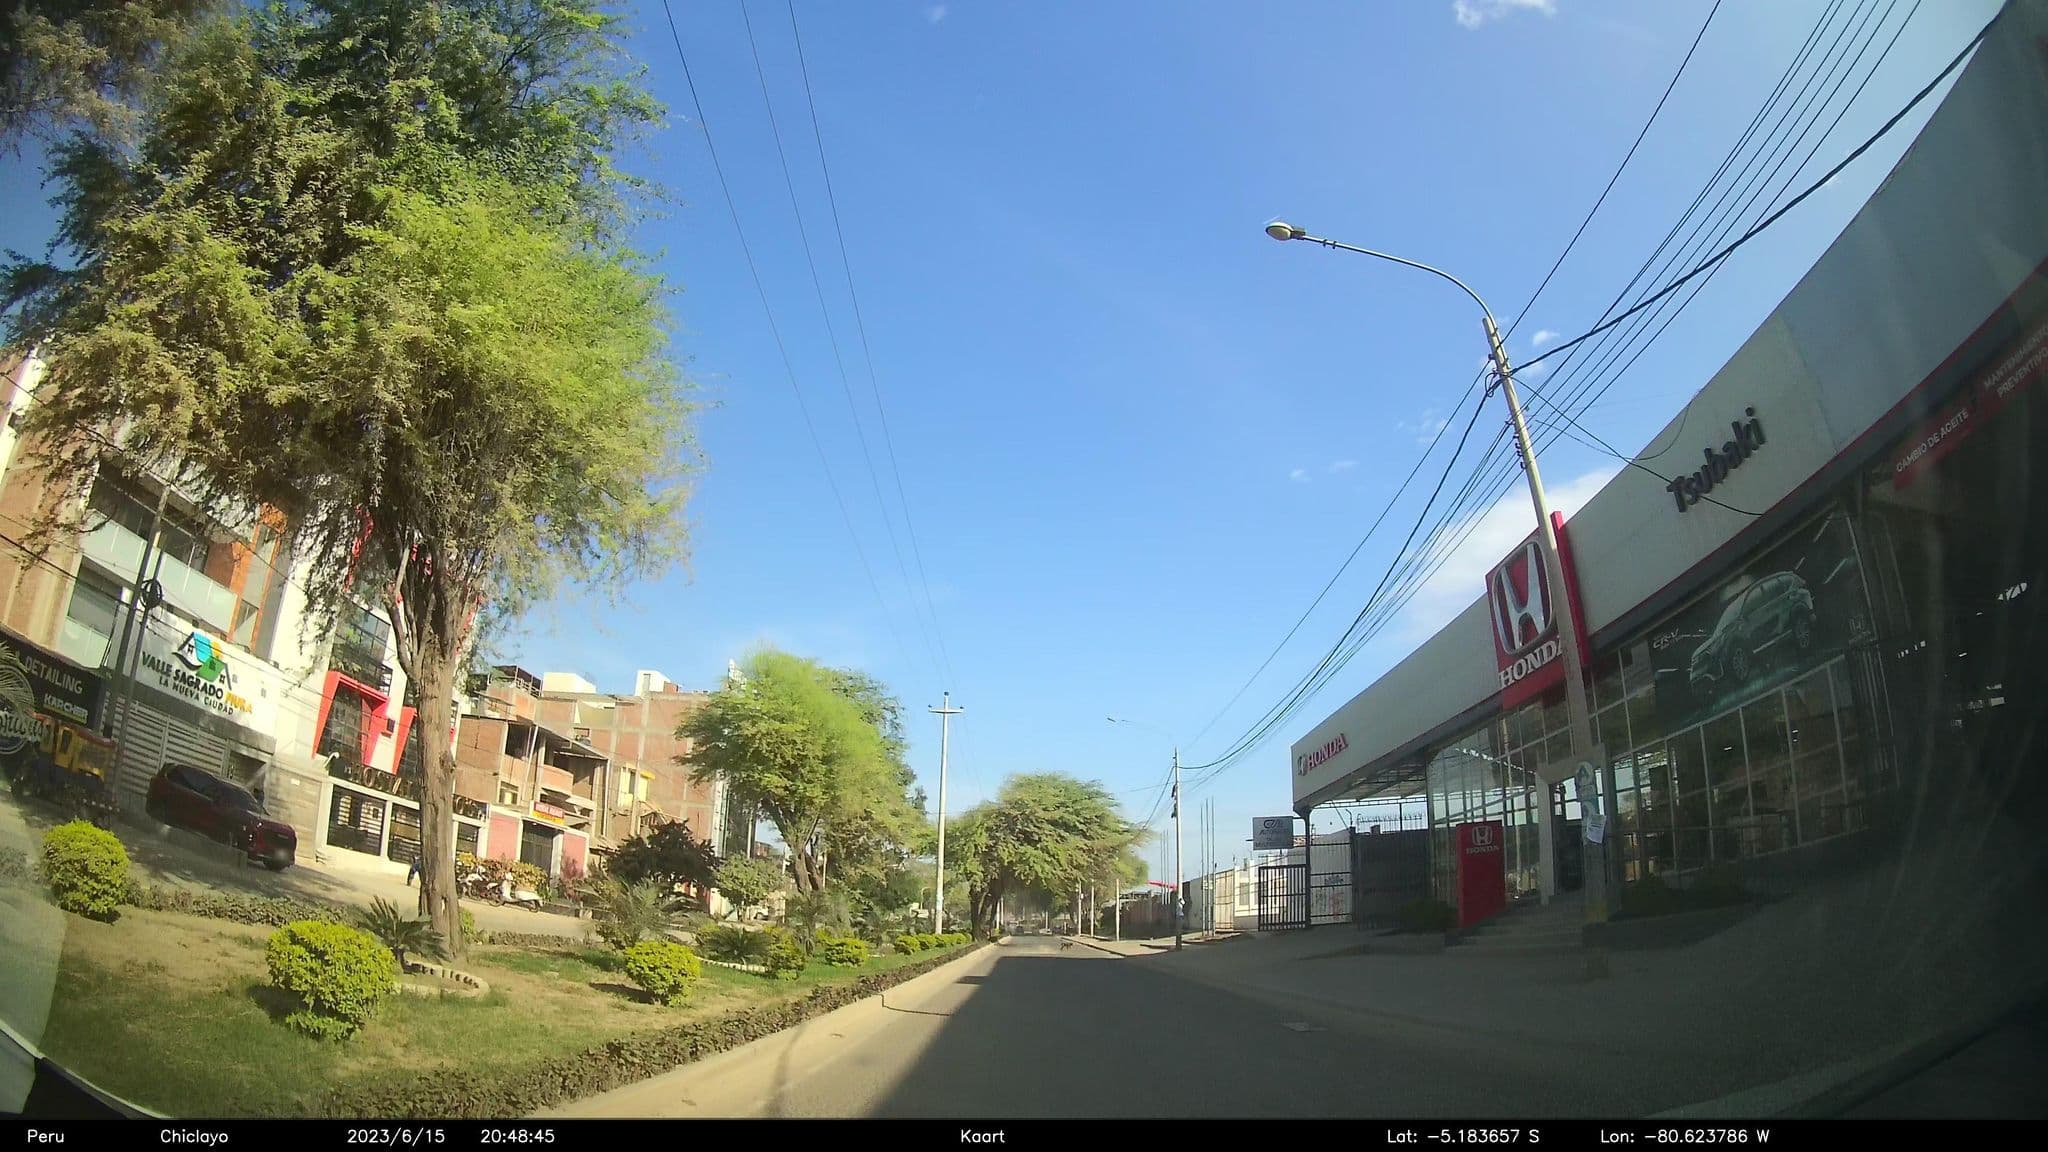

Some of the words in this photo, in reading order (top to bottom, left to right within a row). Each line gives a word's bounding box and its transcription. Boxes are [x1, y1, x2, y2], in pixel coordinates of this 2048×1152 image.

[1666, 407, 1765, 512] Tsubaki
[1896, 442, 1927, 472] CAMBIO
[1927, 433, 1940, 449] DE
[25, 656, 82, 694] DETAILING
[141, 651, 172, 677] VALLE
[173, 669, 224, 699] SAGRADO
[159, 676, 169, 688] LA
[172, 681, 200, 702] NUEVA
[204, 696, 234, 716] CIUDAD
[1307, 733, 1348, 769] HONDA
